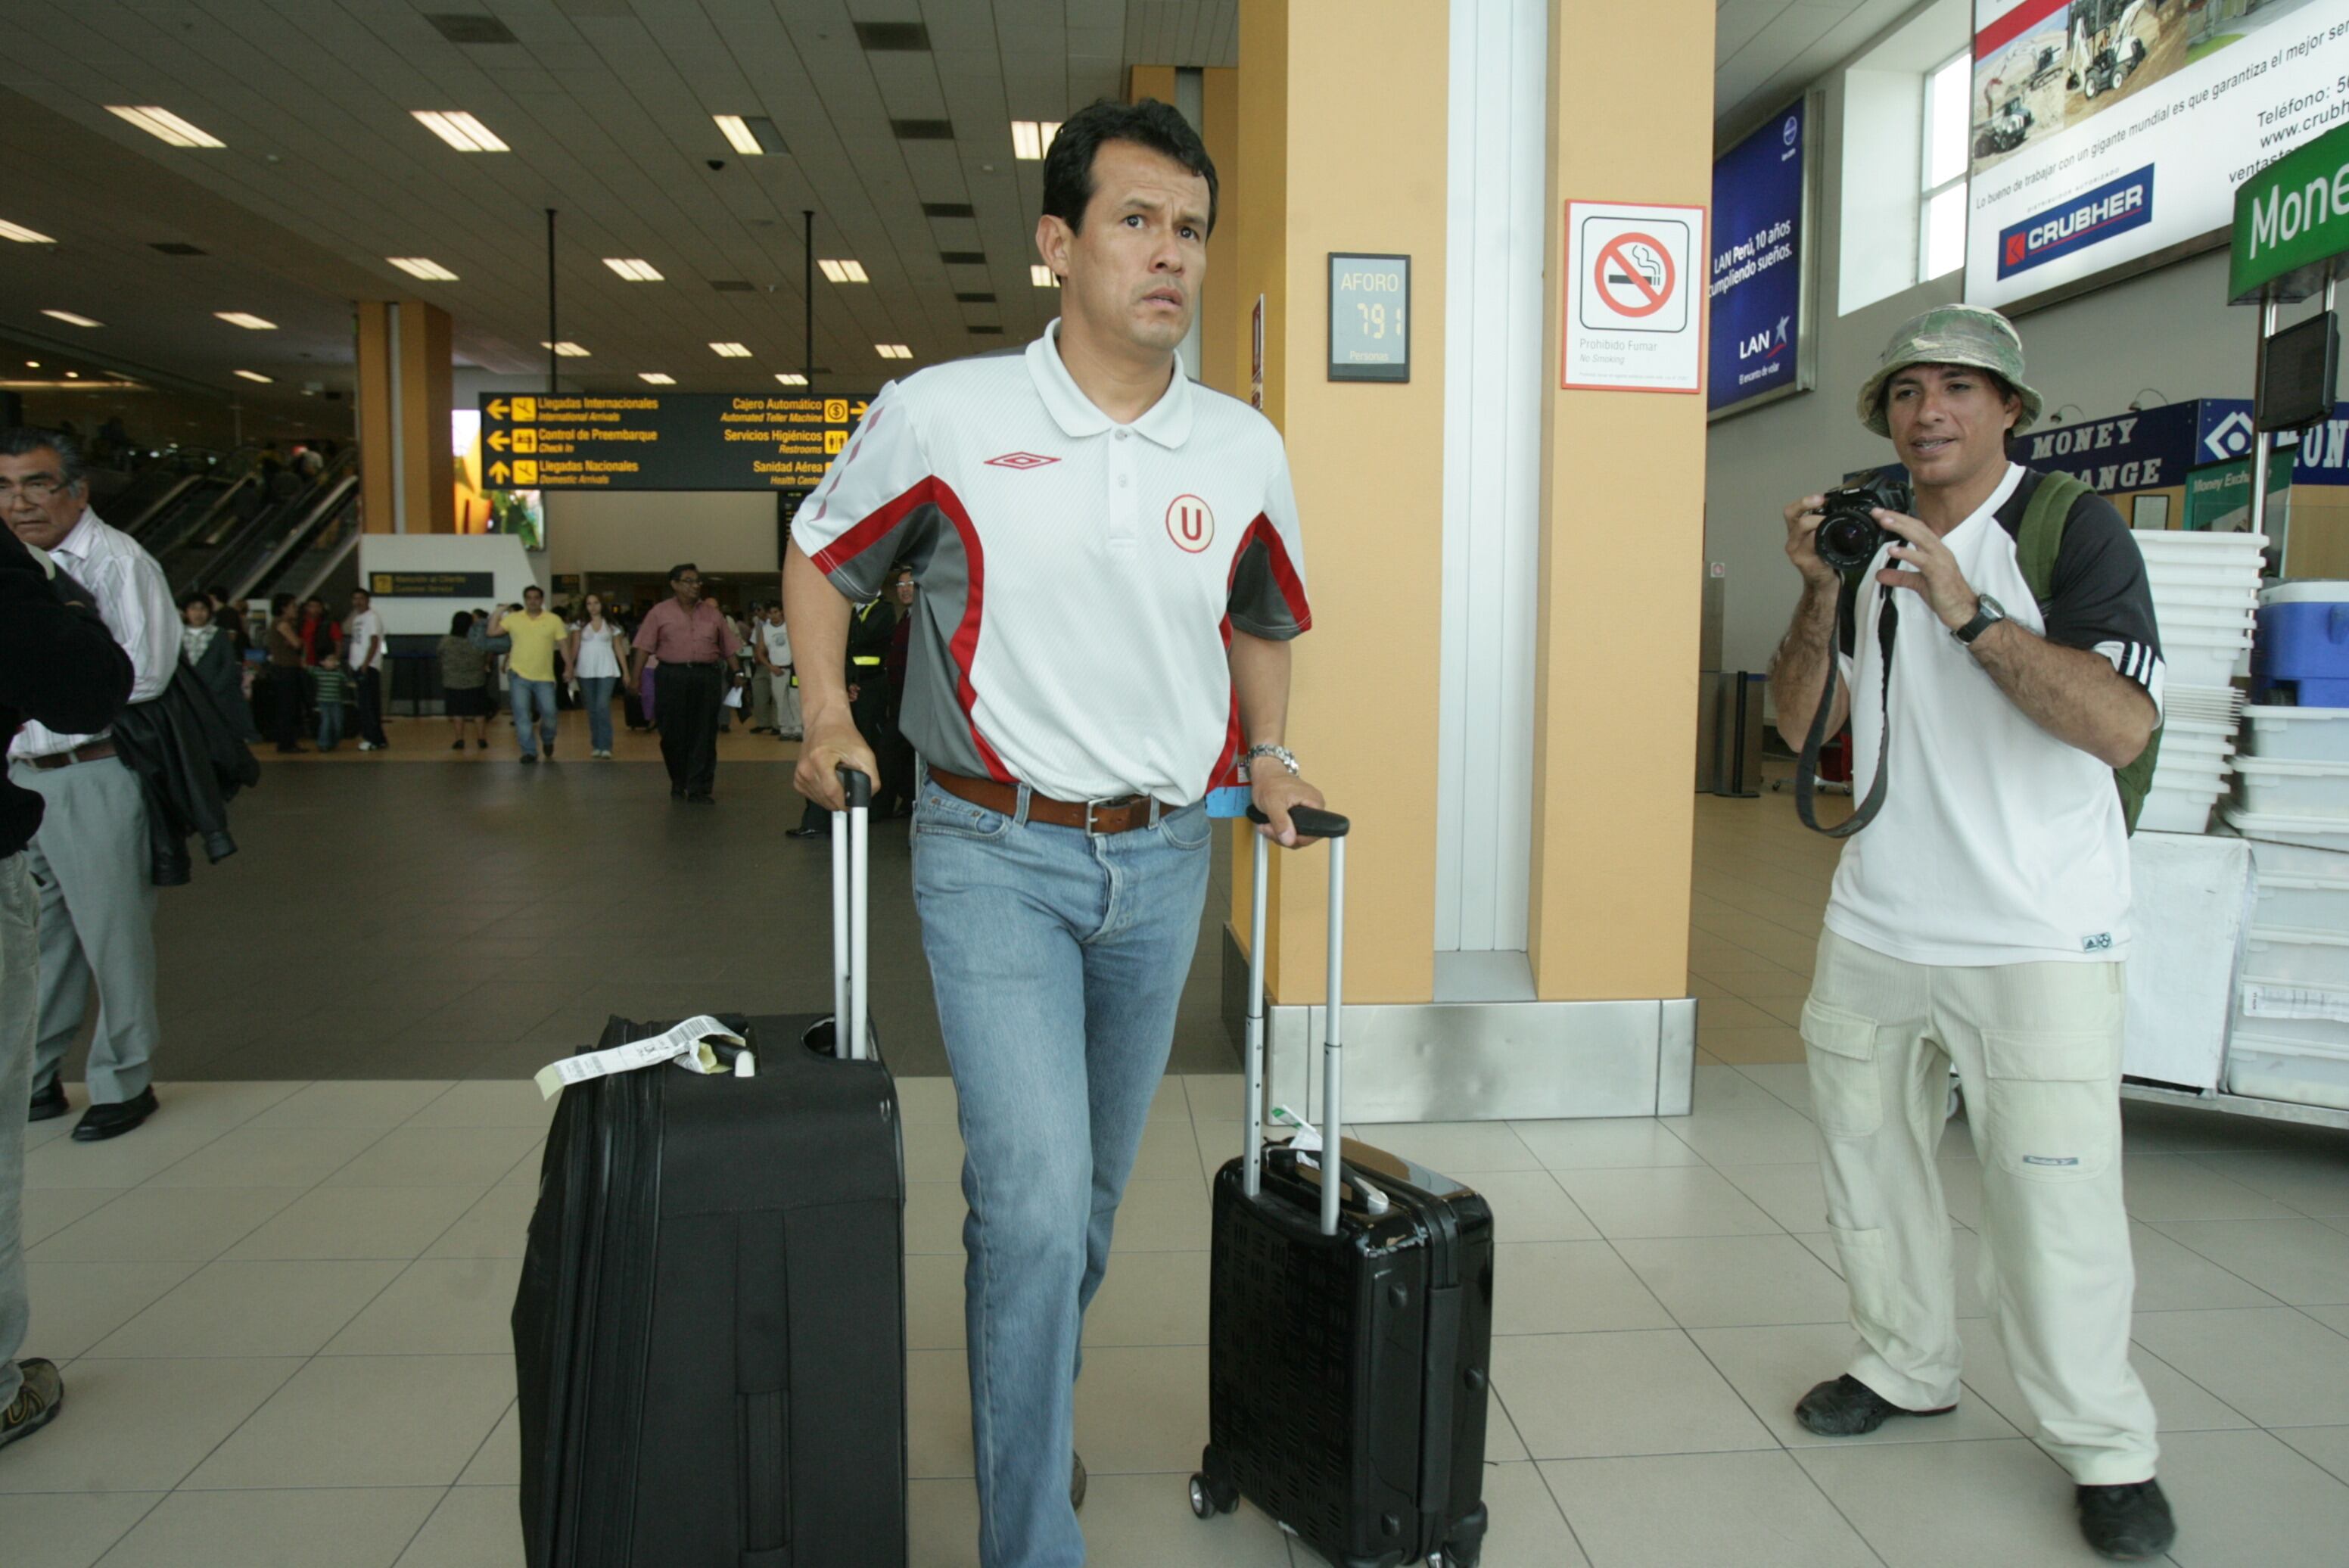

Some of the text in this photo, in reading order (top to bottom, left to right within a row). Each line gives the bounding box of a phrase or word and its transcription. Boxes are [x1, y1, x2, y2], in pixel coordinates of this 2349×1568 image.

[2257, 86, 2330, 127] Teléfono:
[1976, 198, 1985, 209] Lo
[1987, 186, 2011, 204] bueno
[2013, 178, 2023, 191] de
[2025, 163, 2056, 188] trabajar
[2058, 155, 2074, 170] con
[2077, 148, 2089, 161] un
[2091, 129, 2126, 157] gigante
[2129, 104, 2170, 137] mundial
[2173, 100, 2185, 115] es
[2188, 89, 2209, 109] que
[2211, 60, 2267, 100] garantiza
[2271, 49, 2282, 68] el
[2286, 32, 2325, 61] mejor
[2028, 184, 2143, 250] CRUBHER
[1714, 250, 1731, 274] LAN
[1755, 230, 1766, 250] 10
[1768, 220, 1791, 244] años
[1757, 243, 1792, 272] sueños.
[1340, 272, 1399, 291] AFORO
[1579, 338, 1658, 352] Prohibido Fumar
[1740, 330, 1769, 359] LAN
[1350, 350, 1389, 362] Personas
[1580, 354, 1625, 365] No Smoking
[538, 397, 659, 411] Llegadas Internacionales
[733, 398, 822, 411] Cajero Automático
[720, 412, 823, 422] Automated Teller Machine
[538, 428, 658, 442] Control de Preembarque
[724, 429, 823, 443] Servicios Higiénicos
[2030, 418, 2138, 460] MONEY
[779, 444, 823, 454] Restrooms
[539, 460, 639, 474] Llegadas Nacionales
[753, 460, 823, 473] Sanidad Aérea
[770, 476, 795, 485] Health
[2068, 458, 2162, 491] ANGE
[2193, 478, 2223, 492] Money
[1181, 506, 1202, 541] U
